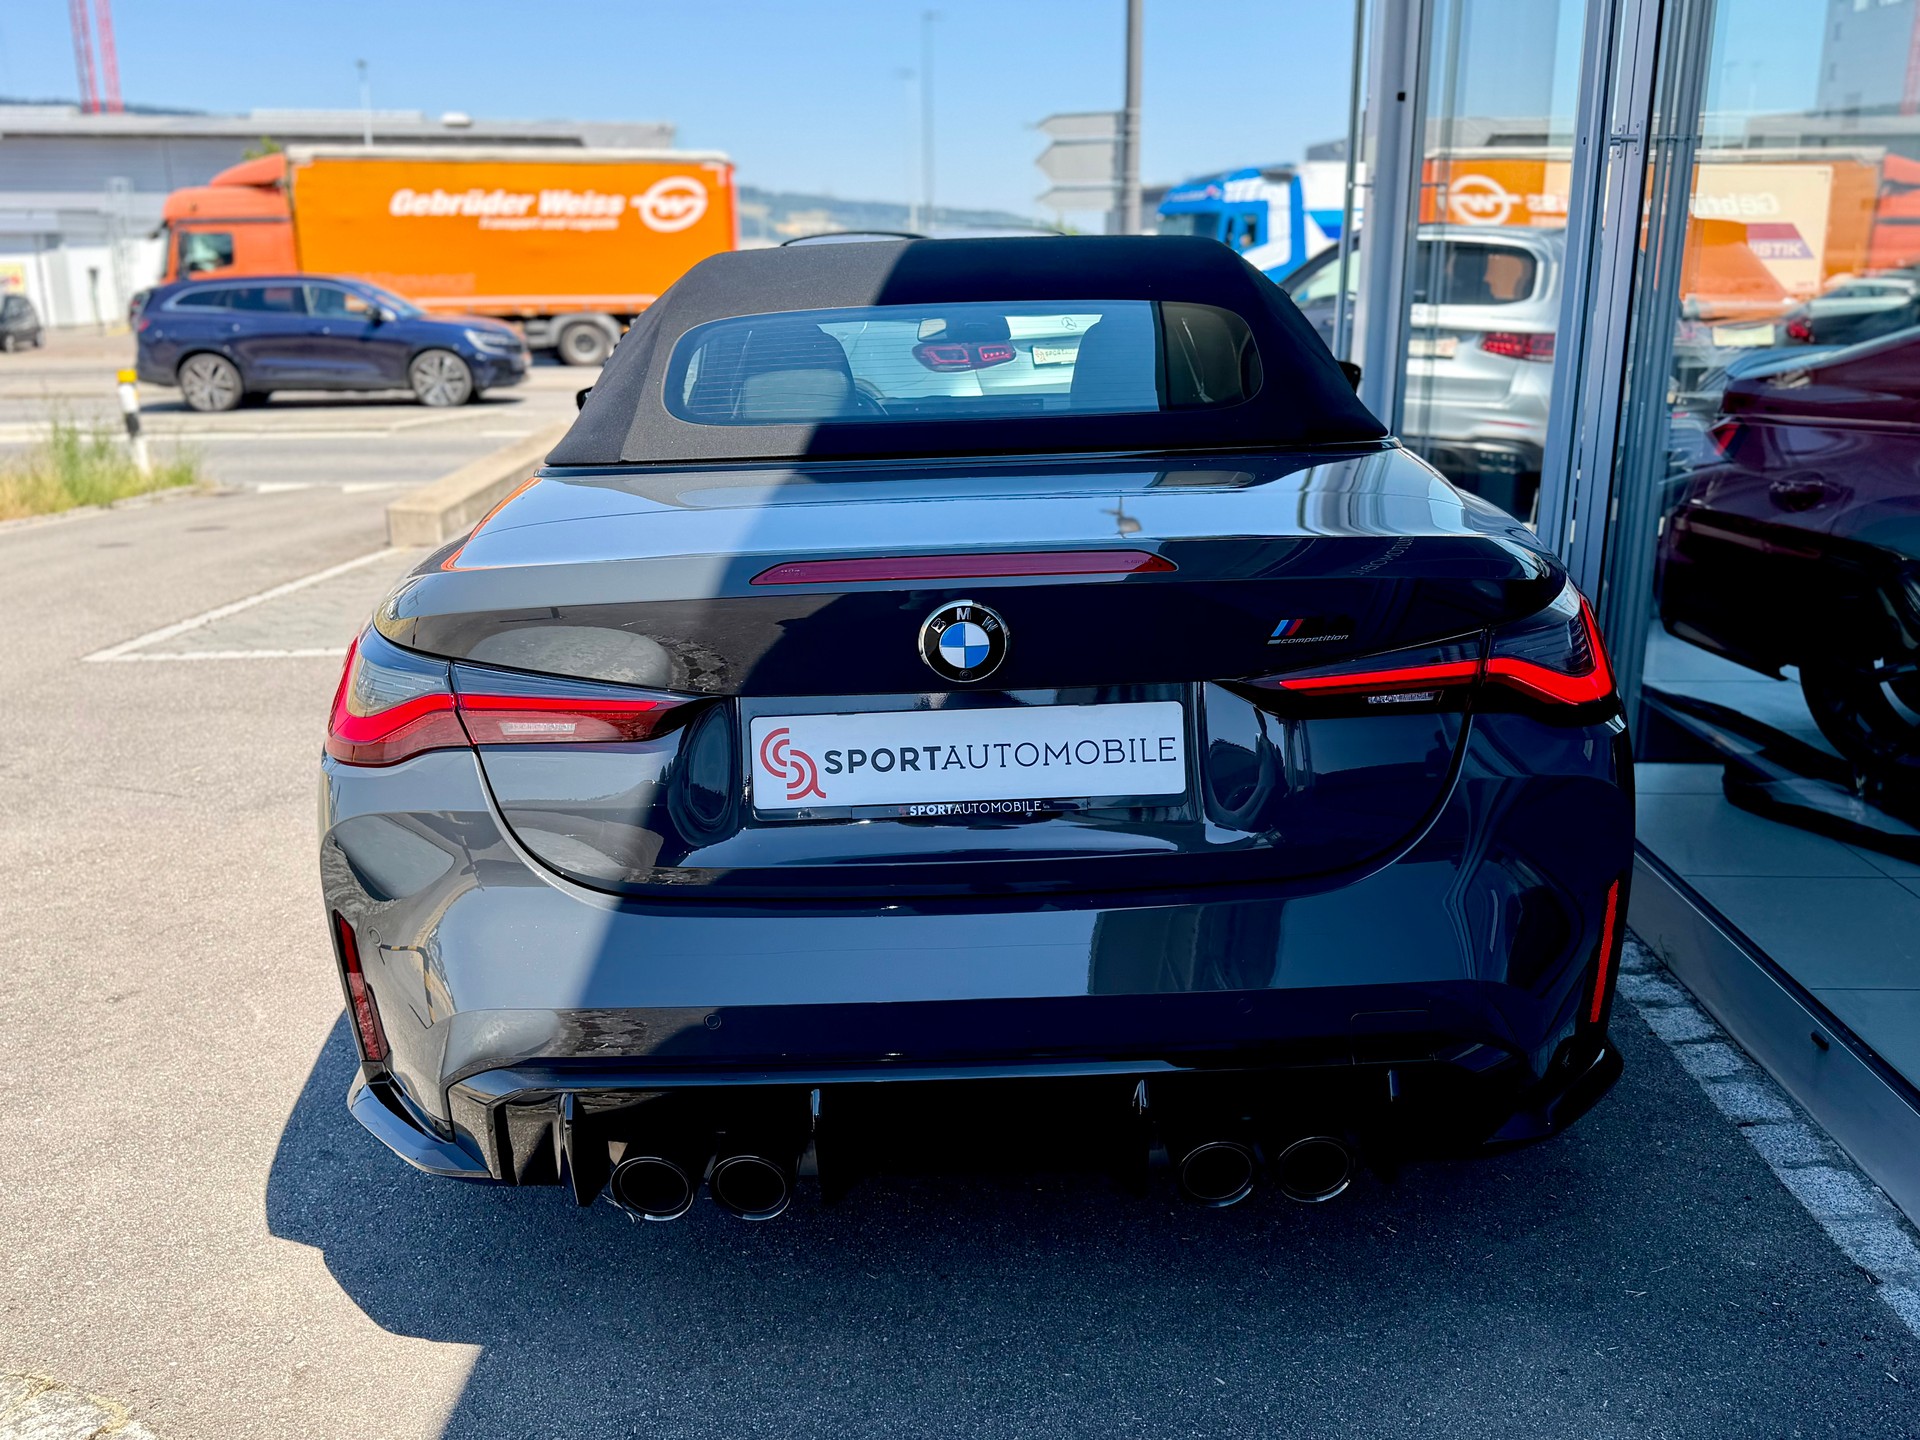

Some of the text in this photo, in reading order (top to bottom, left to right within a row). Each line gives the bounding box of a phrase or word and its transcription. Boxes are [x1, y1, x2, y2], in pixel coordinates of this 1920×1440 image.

[389, 188, 626, 216] Gebrüder Weiss
[931, 607, 998, 634] BMW
[1280, 634, 1349, 644] competition
[824, 736, 1177, 775] SPORTAUTOMOBILE
[909, 800, 1042, 816] SPORTAUTOMOBILE
